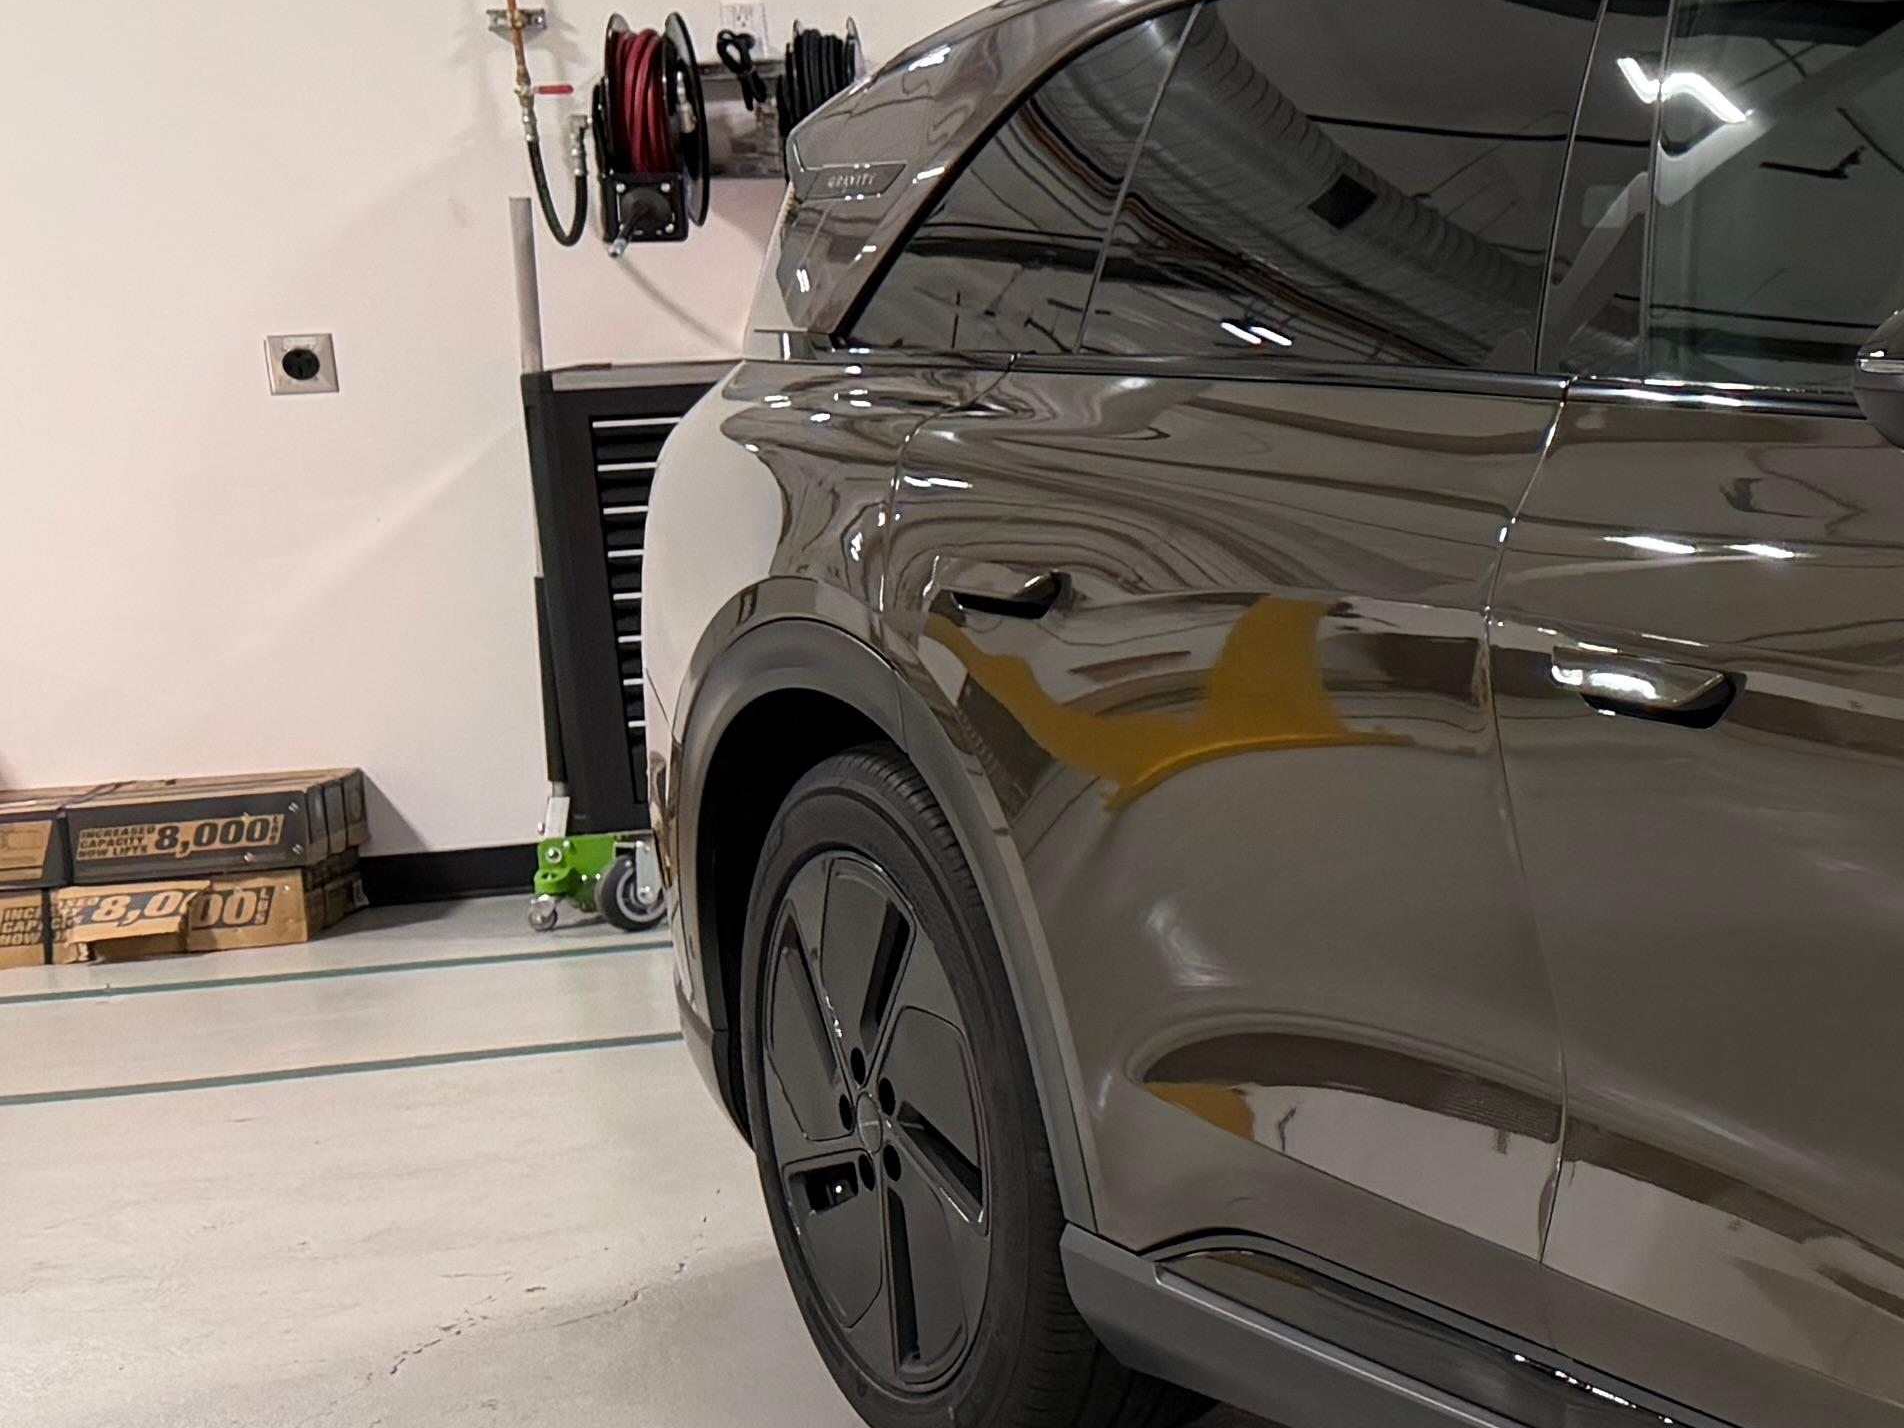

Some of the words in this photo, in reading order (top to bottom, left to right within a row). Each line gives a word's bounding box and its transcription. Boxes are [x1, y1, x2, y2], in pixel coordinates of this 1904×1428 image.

[81, 826, 156, 838] INCREASED
[155, 818, 270, 855] 8,000
[80, 836, 144, 849] CAPACITY
[78, 848, 108, 858] NOW
[113, 845, 148, 856] LIFTS
